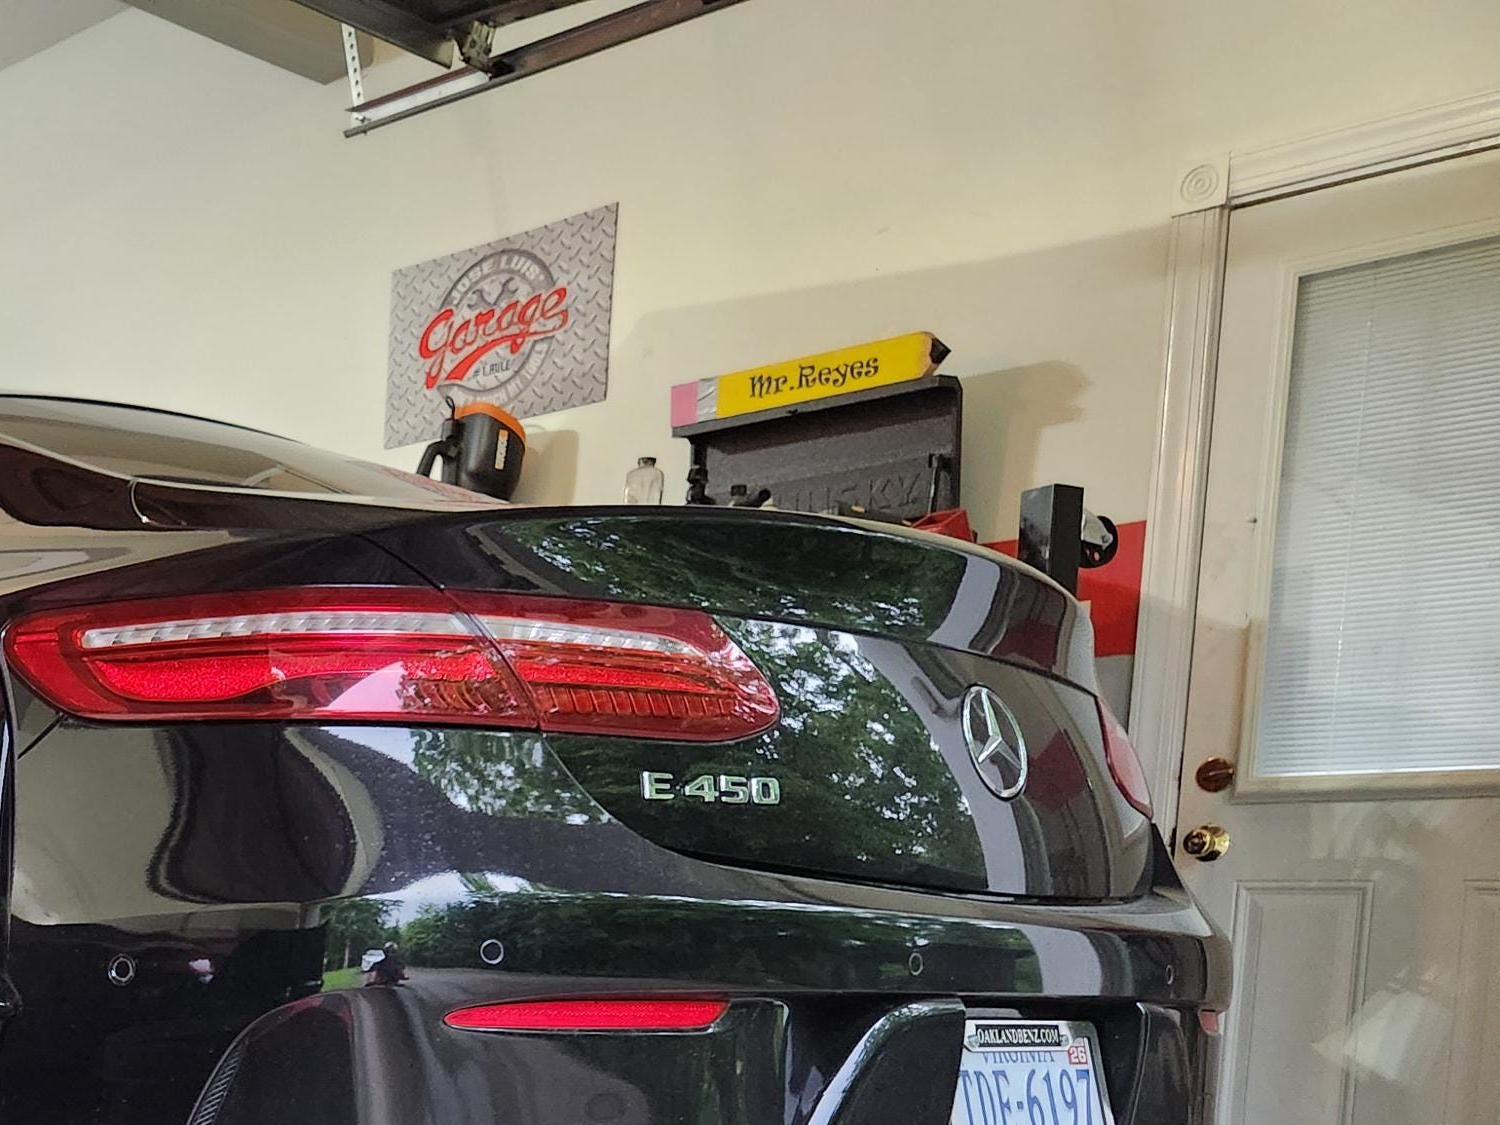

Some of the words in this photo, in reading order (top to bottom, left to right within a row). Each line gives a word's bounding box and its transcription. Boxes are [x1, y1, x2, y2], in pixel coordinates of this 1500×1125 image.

[451, 258, 495, 306] JOSE
[419, 287, 567, 390] Garage
[683, 774, 781, 805] 450
[976, 1027, 1060, 1045] OAKLANDBENZ.COM
[1069, 1047, 1087, 1065] 26
